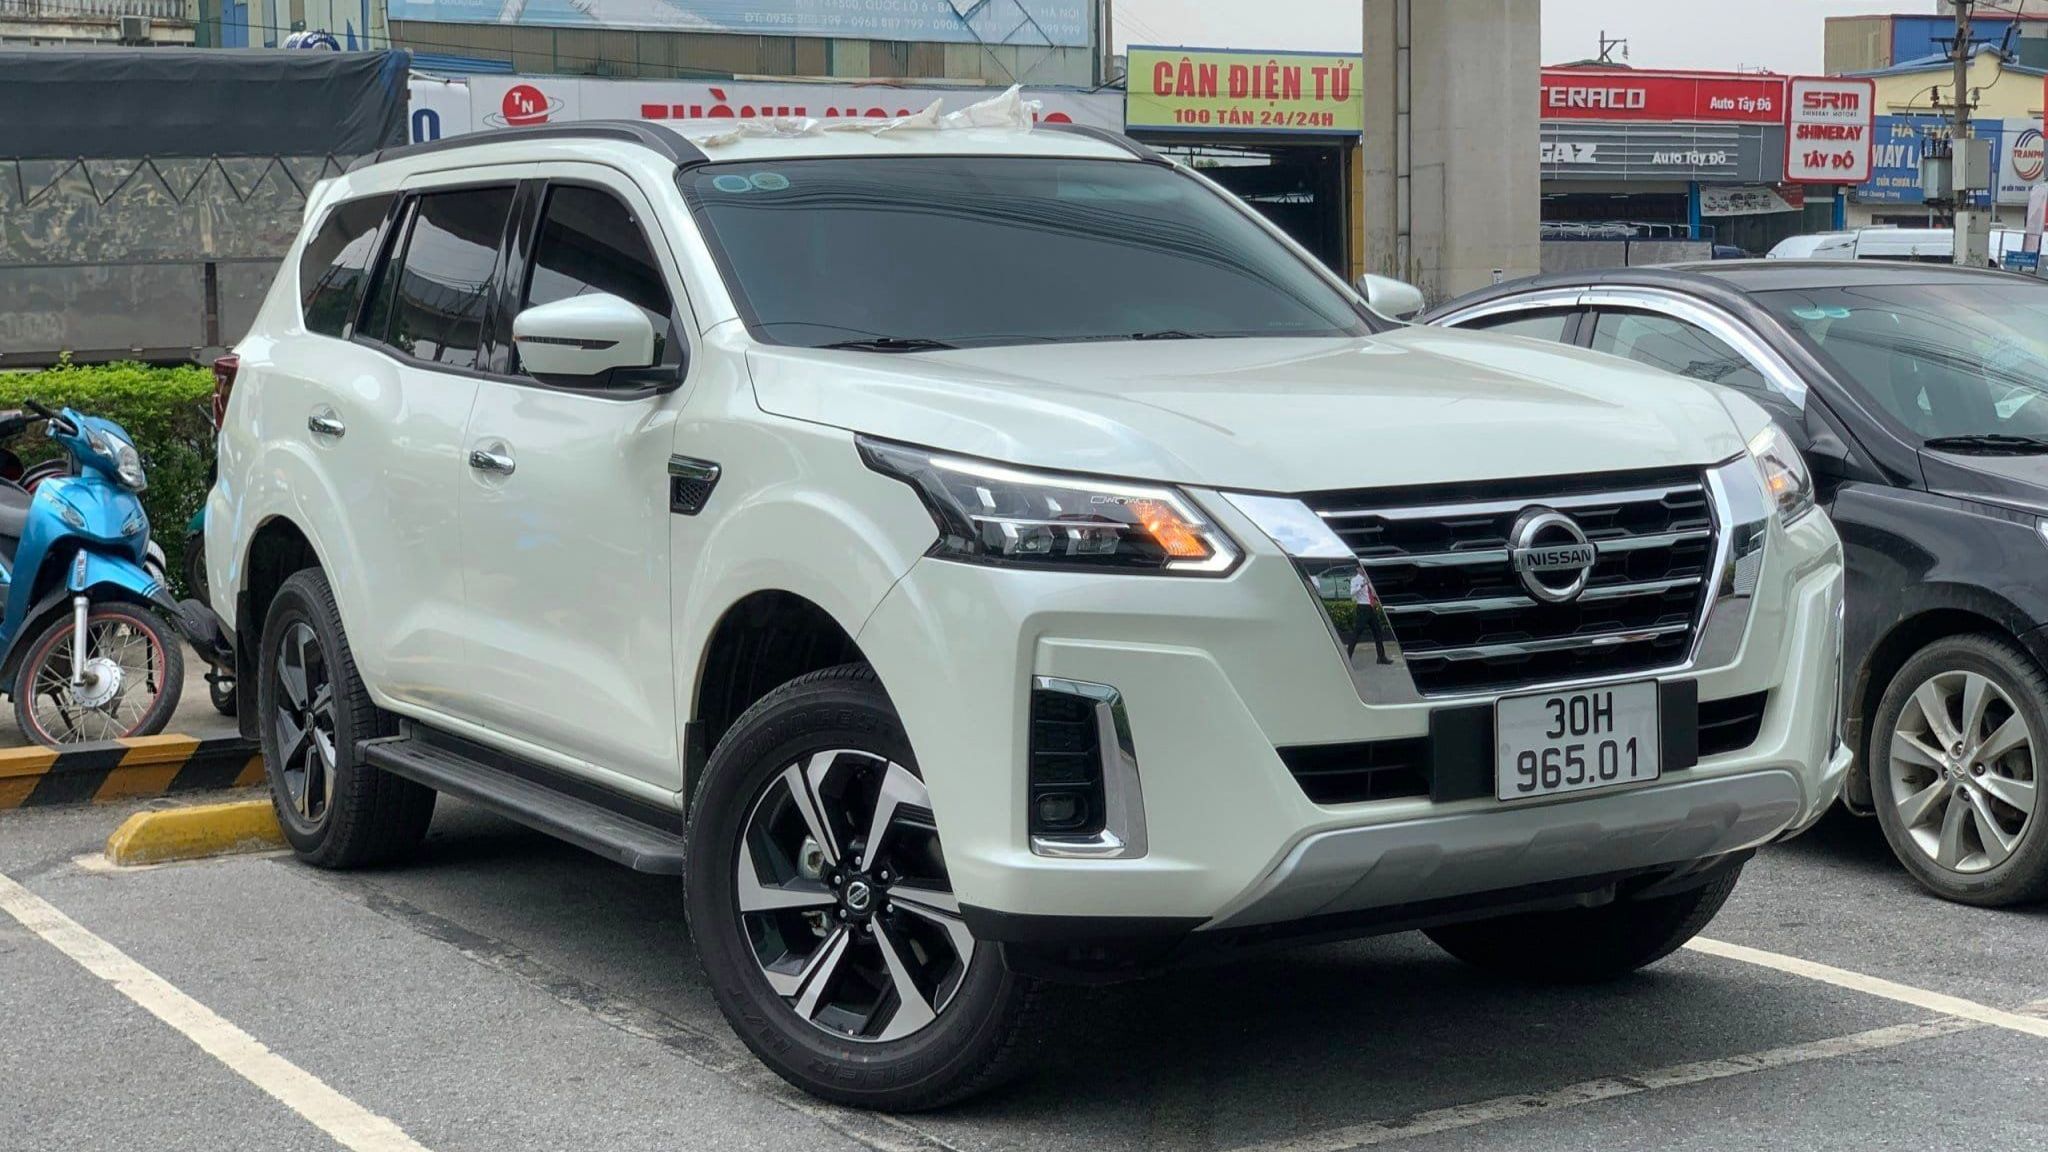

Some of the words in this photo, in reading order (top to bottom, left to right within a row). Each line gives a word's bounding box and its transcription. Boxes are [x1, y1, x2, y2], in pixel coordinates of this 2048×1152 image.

[1153, 57, 1218, 97] CÂN
[1228, 60, 1301, 107] ĐIỆN
[1311, 60, 1353, 102] TỬ
[1710, 96, 1734, 110] Auto
[1737, 96, 1755, 113] Tây
[1756, 97, 1772, 111] Đô
[1803, 91, 1859, 110] SRM
[1174, 108, 1210, 124] 100
[1216, 106, 1254, 125] TẤN
[1260, 110, 1334, 127] 24/24H
[1796, 124, 1863, 141] SHINERAY
[1652, 151, 1682, 164] Auto
[1685, 150, 1706, 166] Tây
[1709, 150, 1727, 165] Đô
[1803, 150, 1828, 168] TÂY
[1527, 548, 1591, 566] NISSAN
[1545, 691, 1613, 739] 30H
[1517, 736, 1637, 792] 965.01
